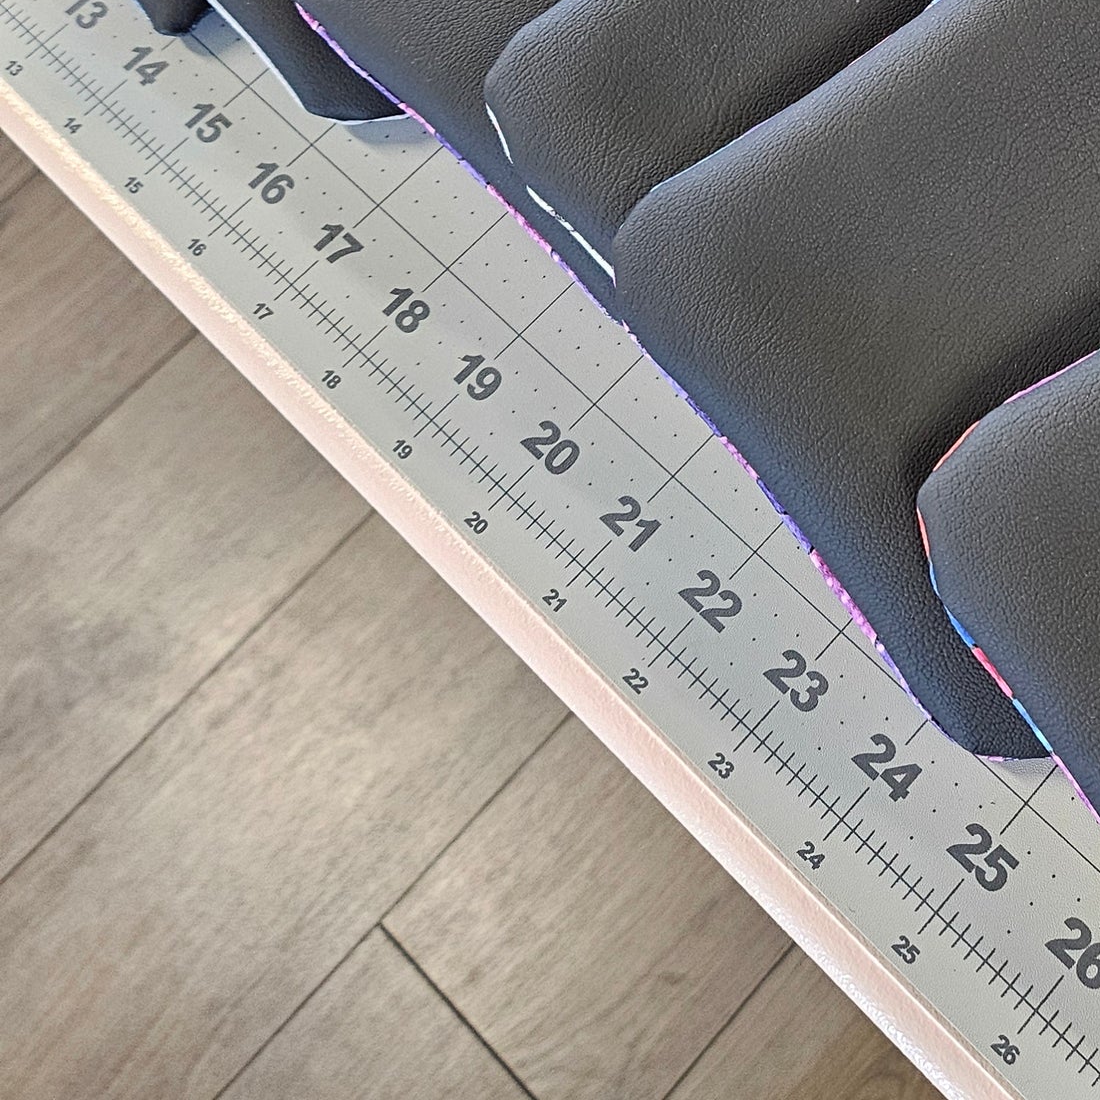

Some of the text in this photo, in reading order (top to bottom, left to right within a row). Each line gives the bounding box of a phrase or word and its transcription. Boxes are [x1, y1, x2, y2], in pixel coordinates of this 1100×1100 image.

[4, 60, 1021, 1066] 13 14 15 16 17 18 19 20 21 22 23 24 25 26
[122, 46, 170, 87] 14
[183, 103, 234, 144] 15
[247, 162, 296, 205] 16
[313, 223, 365, 264] 17
[381, 287, 431, 334] 18
[452, 354, 503, 401] 19
[519, 420, 581, 476] 20
[599, 495, 663, 553] 21
[677, 569, 743, 634] 22
[762, 649, 830, 713] 23
[850, 733, 923, 803] 24
[945, 822, 1020, 893] 25
